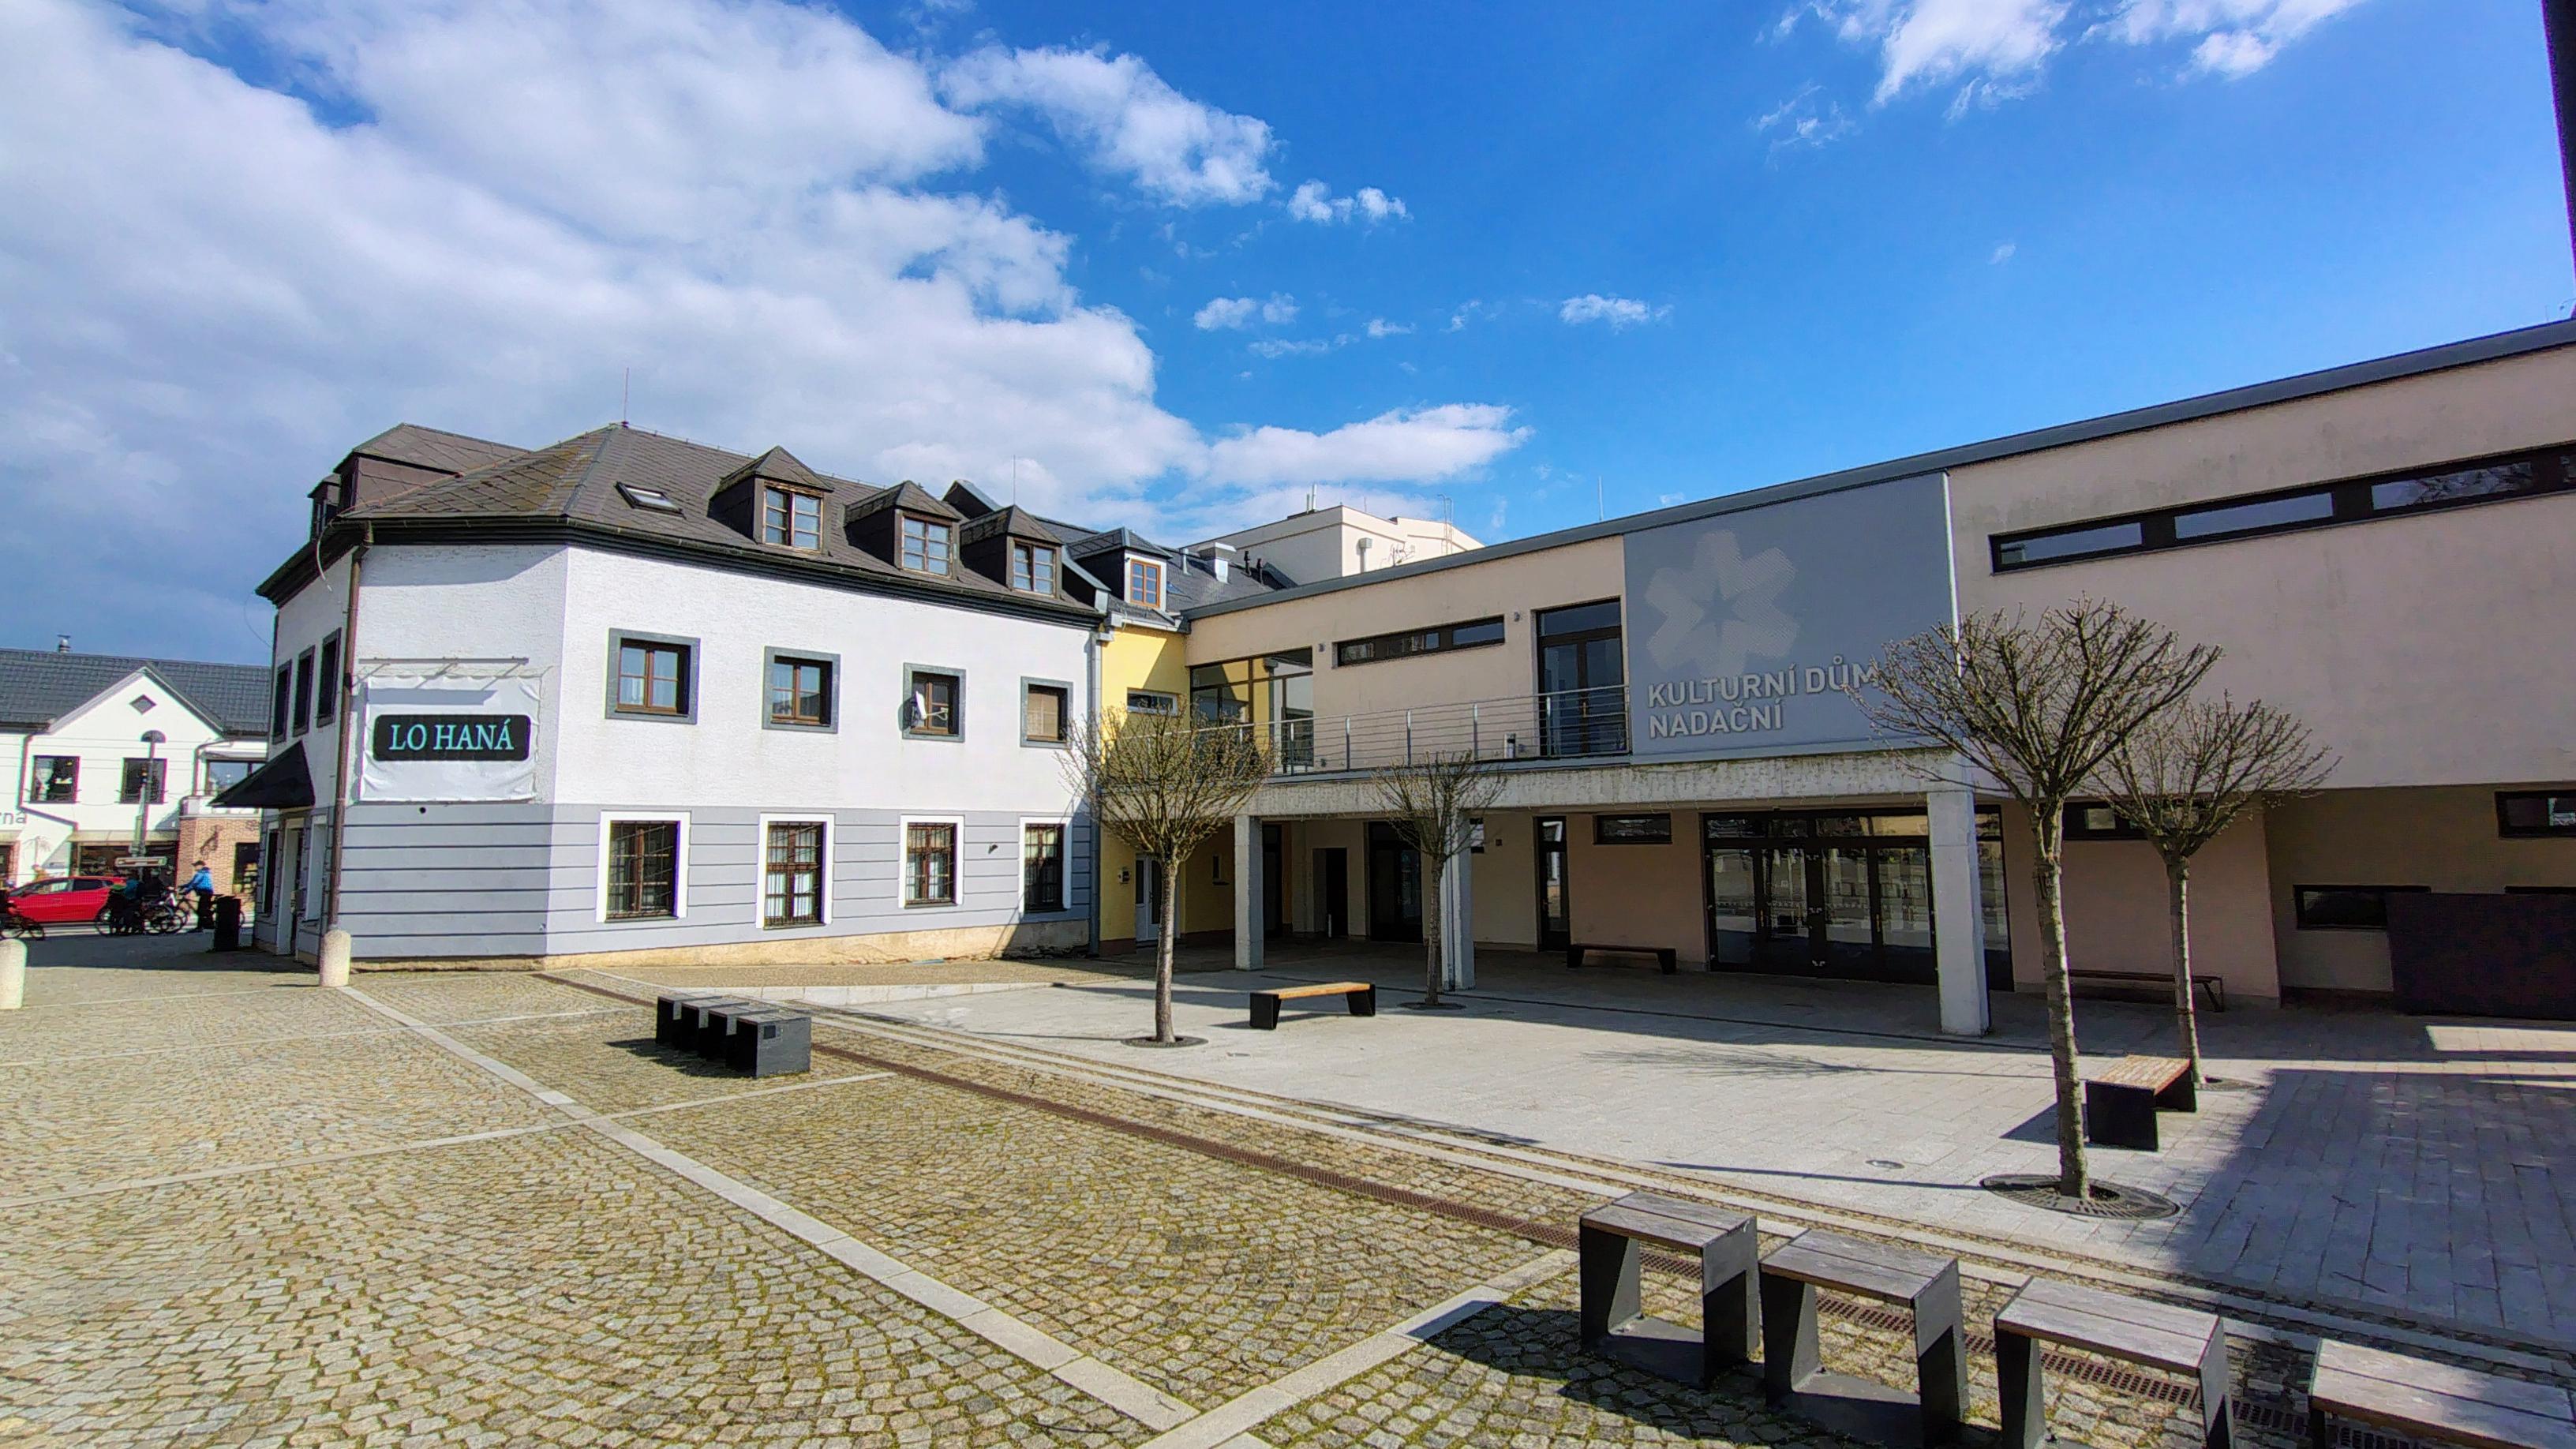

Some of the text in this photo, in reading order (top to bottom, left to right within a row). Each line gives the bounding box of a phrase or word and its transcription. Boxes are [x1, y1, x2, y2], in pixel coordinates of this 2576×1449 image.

[1648, 654, 1881, 709] KULTURNÍ DŮM
[388, 717, 515, 751] LO HANÁ
[1649, 698, 1784, 739] NADAČNÍ
